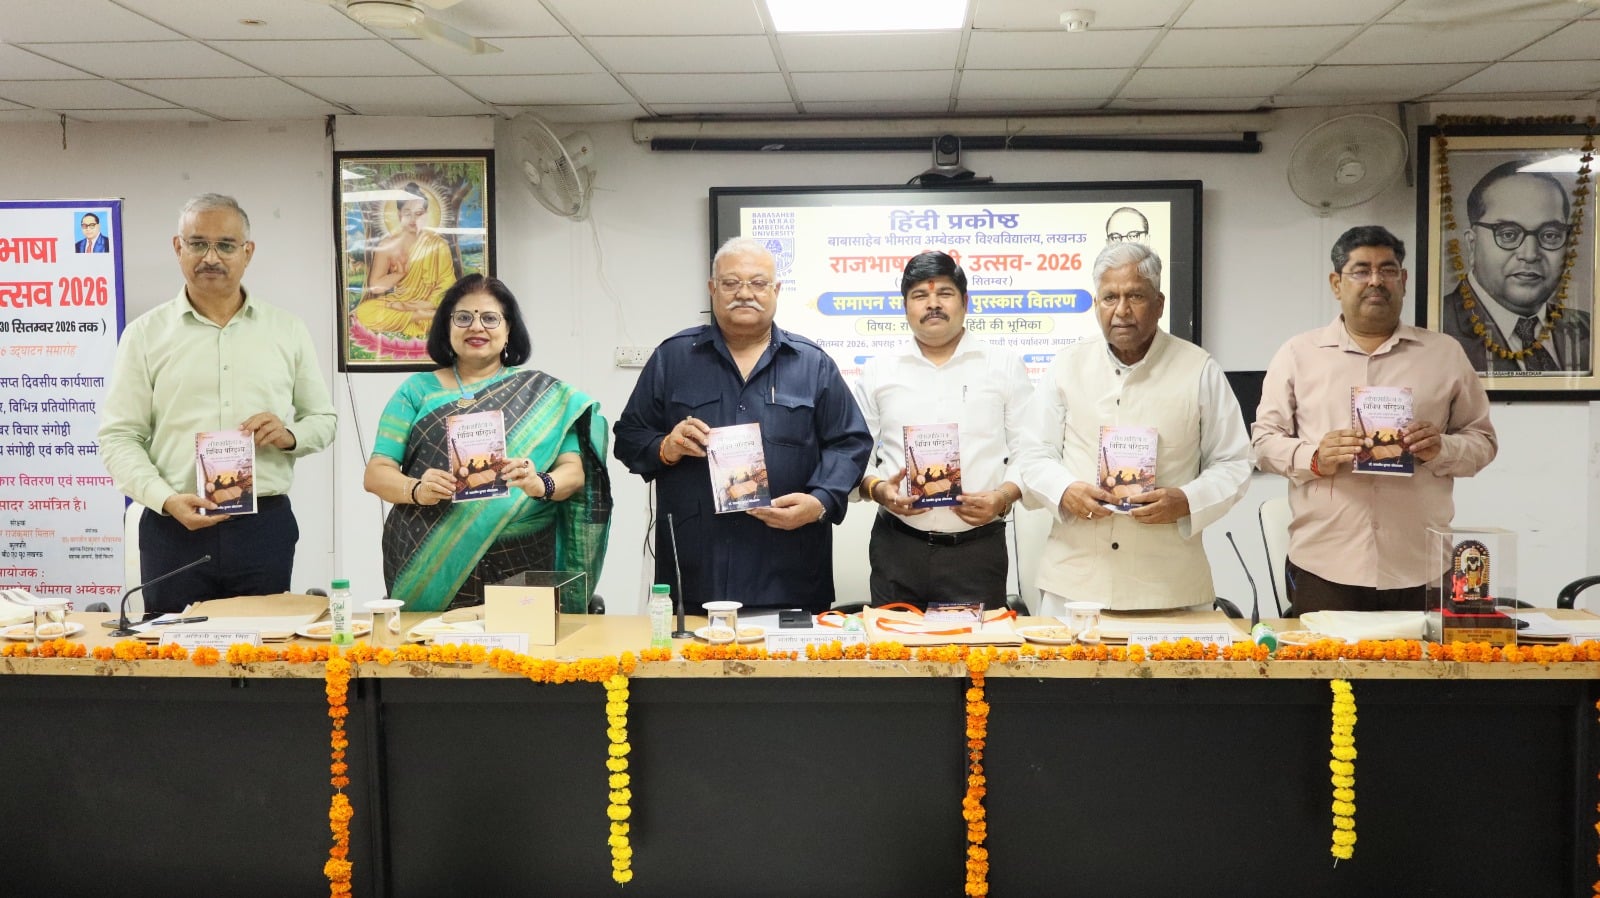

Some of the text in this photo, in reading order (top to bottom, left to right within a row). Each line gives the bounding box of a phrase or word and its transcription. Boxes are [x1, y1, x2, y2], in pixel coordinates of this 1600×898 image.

[888, 208, 1019, 232] हिंदी प्रकोष्ठ
[827, 234, 881, 248] बाबासाहेब
[885, 233, 921, 247] भीमराव
[925, 232, 971, 246] अम्बेडकर
[1046, 233, 1087, 244] लखनऊ
[829, 256, 911, 274] राजभाष
[1037, 253, 1082, 271] 2026
[58, 276, 108, 307] 2026
[832, 296, 883, 311] समापन
[971, 293, 1023, 313] पुरस्कार
[1027, 291, 1077, 310] वितरण
[12, 318, 54, 334] सितम्बर
[55, 321, 76, 333] 2026
[78, 322, 99, 333] तक
[966, 318, 986, 331] हिंदी
[989, 317, 1003, 330] की
[1007, 318, 1042, 332] भूमिका
[22, 374, 57, 388] दिवसीय
[60, 373, 104, 388] कार्यशाला
[9, 398, 38, 412] विभिन्न
[40, 398, 96, 414] प्रतियोगिताएं
[13, 421, 39, 435] विचार
[41, 420, 71, 437] संगोष्ठी
[6, 441, 99, 458] संगोष्ठी एवं कवि सम्मे
[19, 473, 54, 486] वितरण
[57, 475, 73, 488] एवं
[76, 476, 114, 487] समापन
[28, 497, 70, 511] आमंत्रित
[35, 581, 72, 595] भीमराव
[76, 582, 122, 595] अम्बेडकर
